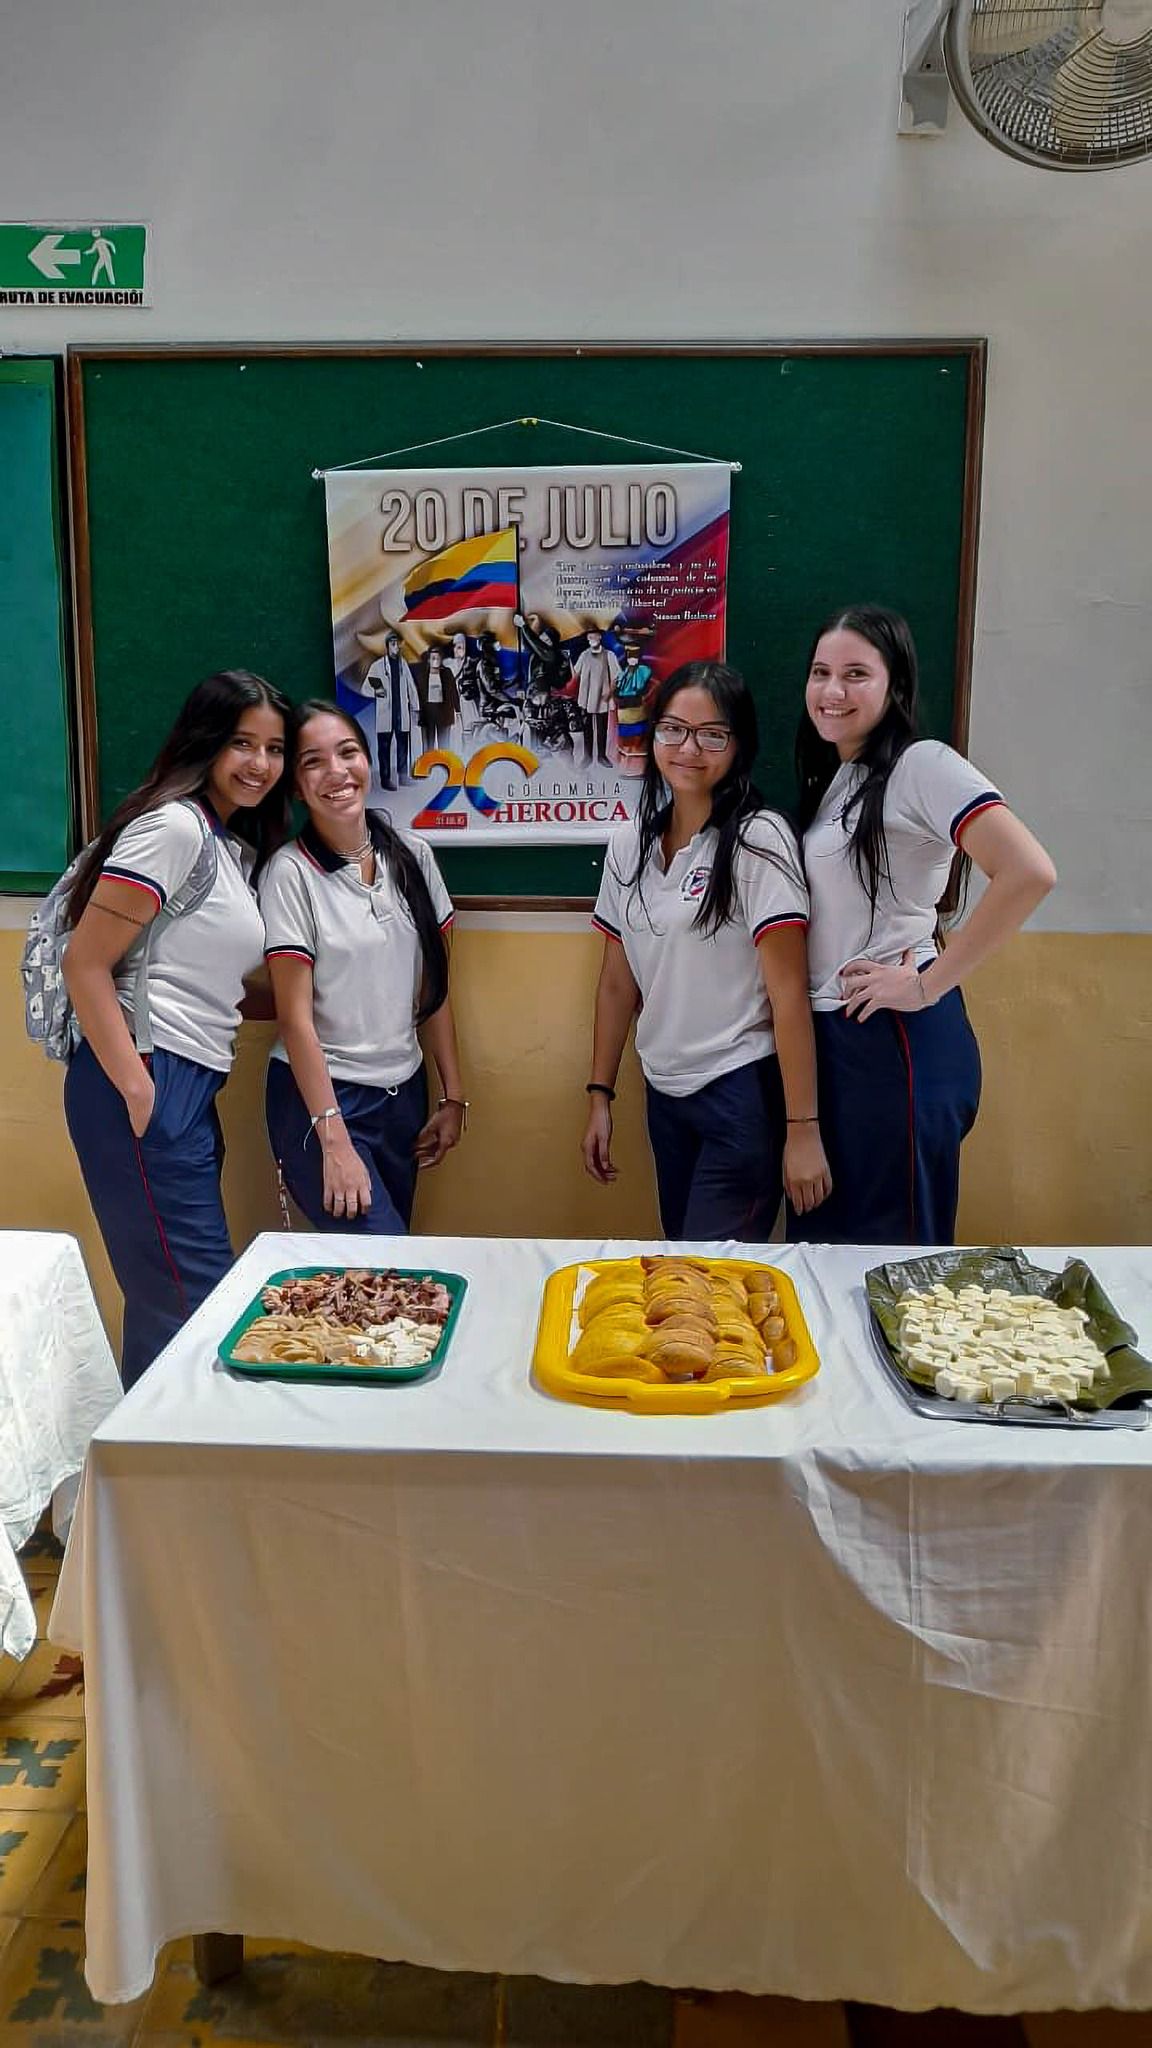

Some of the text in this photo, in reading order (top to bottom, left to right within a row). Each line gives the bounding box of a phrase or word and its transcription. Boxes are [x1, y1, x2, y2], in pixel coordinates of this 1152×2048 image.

[0, 291, 35, 304] RUTA
[37, 291, 56, 304] DE
[380, 487, 448, 552] 20
[540, 481, 678, 550] JULIO
[507, 782, 622, 797] COLOMBIA
[493, 800, 630, 823] HEROICA
